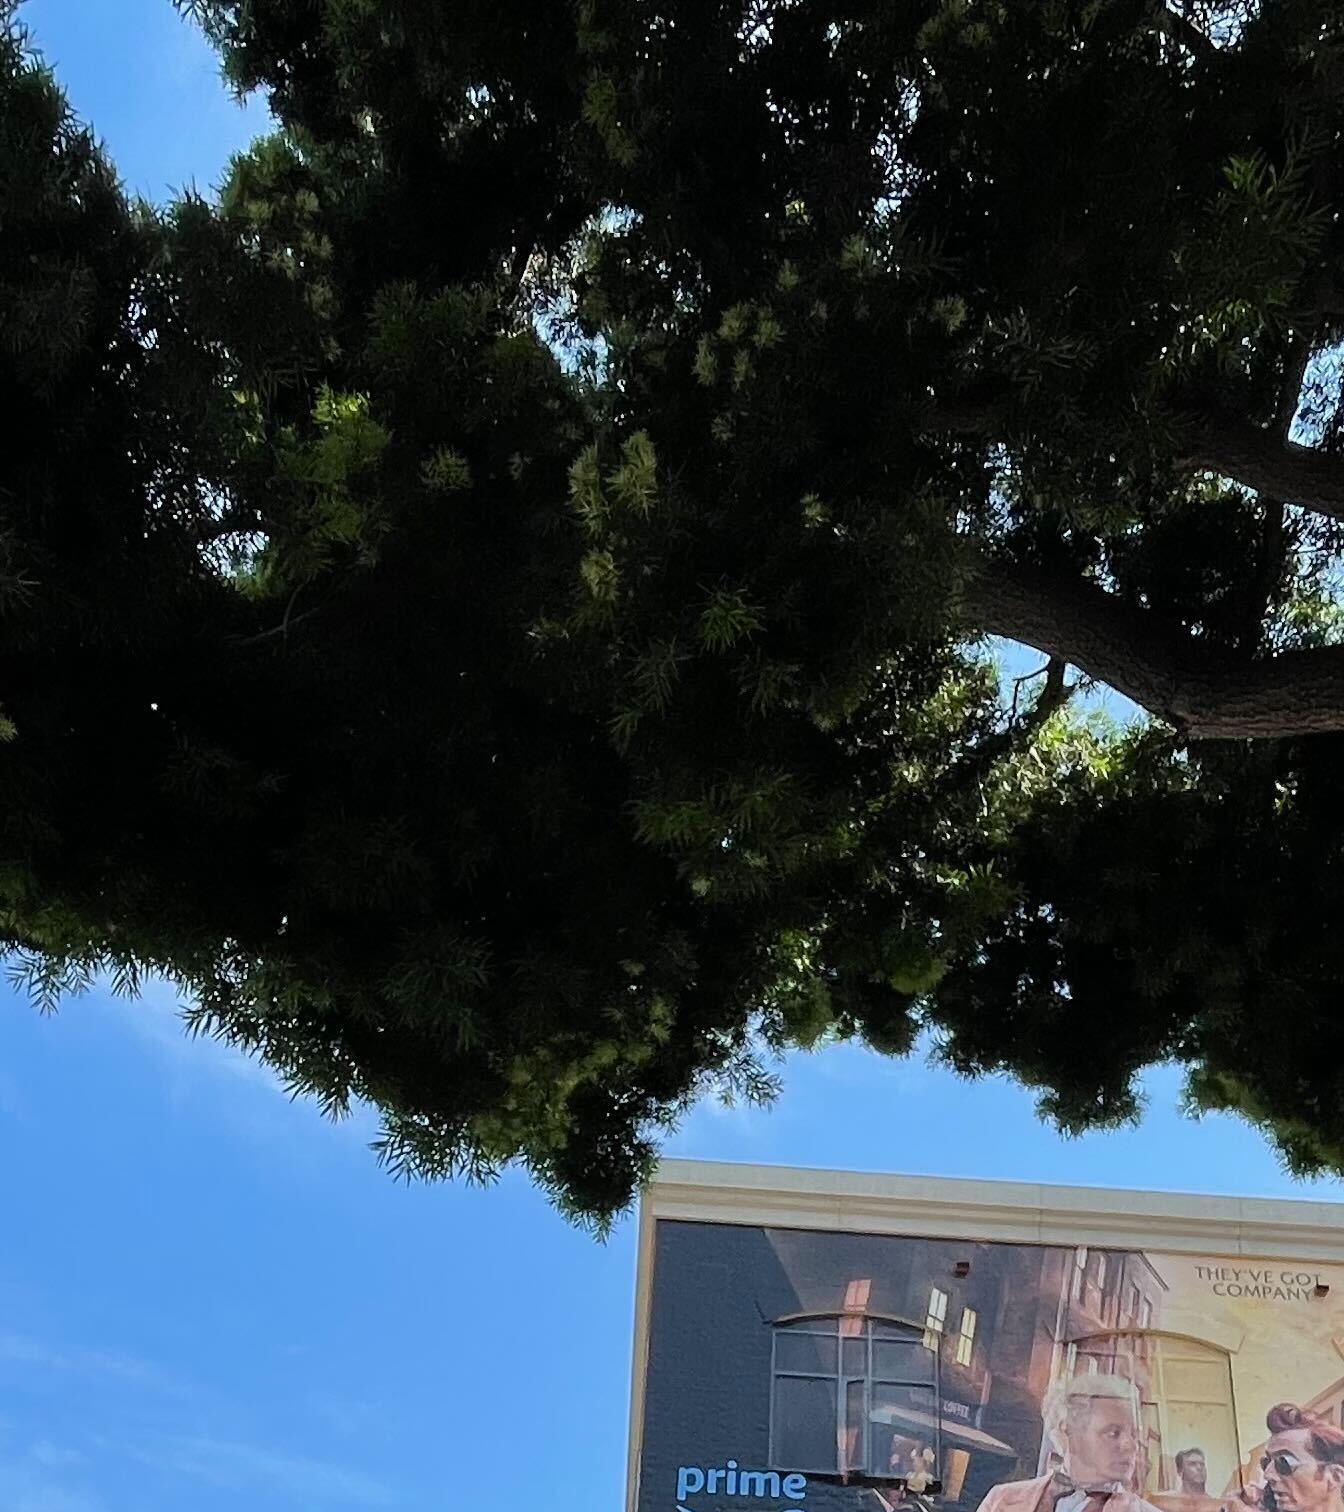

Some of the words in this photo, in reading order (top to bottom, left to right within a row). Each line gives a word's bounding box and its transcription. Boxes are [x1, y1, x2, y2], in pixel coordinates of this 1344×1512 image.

[1194, 1265, 1274, 1285] THEY'VE
[1280, 1271, 1324, 1288] GOT
[1212, 1282, 1316, 1302] COMPANY
[676, 1459, 807, 1501] prime
